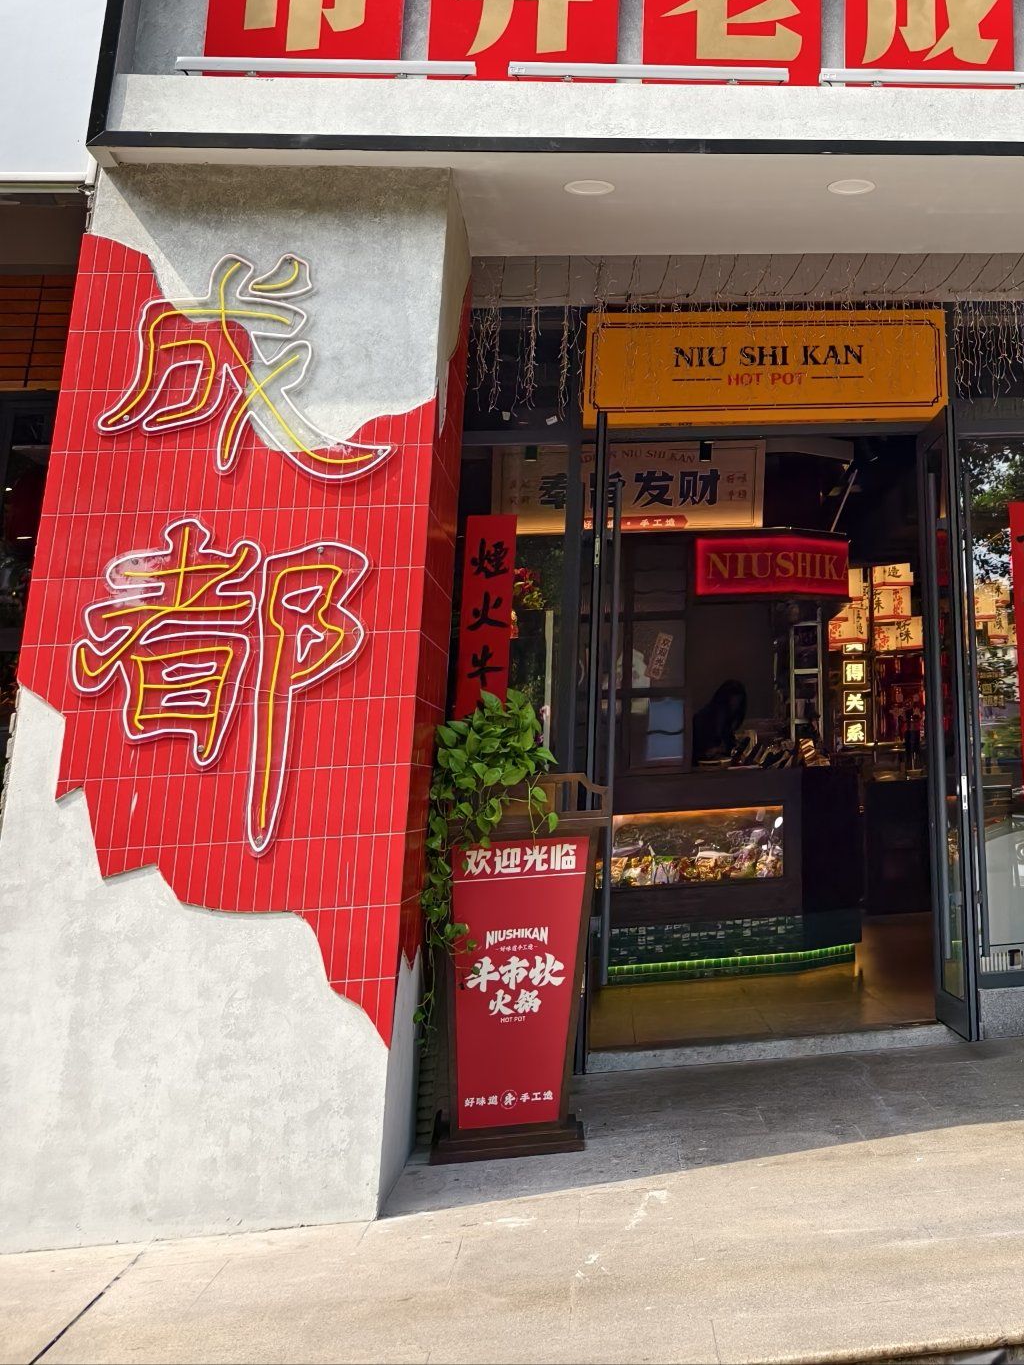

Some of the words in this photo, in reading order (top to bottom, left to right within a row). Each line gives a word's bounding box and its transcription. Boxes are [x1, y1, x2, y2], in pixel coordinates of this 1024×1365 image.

[673, 345, 727, 368] NIU
[739, 345, 789, 367] SHI
[802, 344, 864, 366] KAN
[728, 374, 761, 386] HOT
[771, 372, 806, 385] POT
[72, 253, 393, 853] 成都
[464, 843, 577, 877] 欢迎光临
[485, 926, 549, 950] NIUSHIKAN
[488, 988, 542, 1016] 火锅
[500, 1016, 513, 1024] HOT
[514, 1015, 526, 1023] POT
